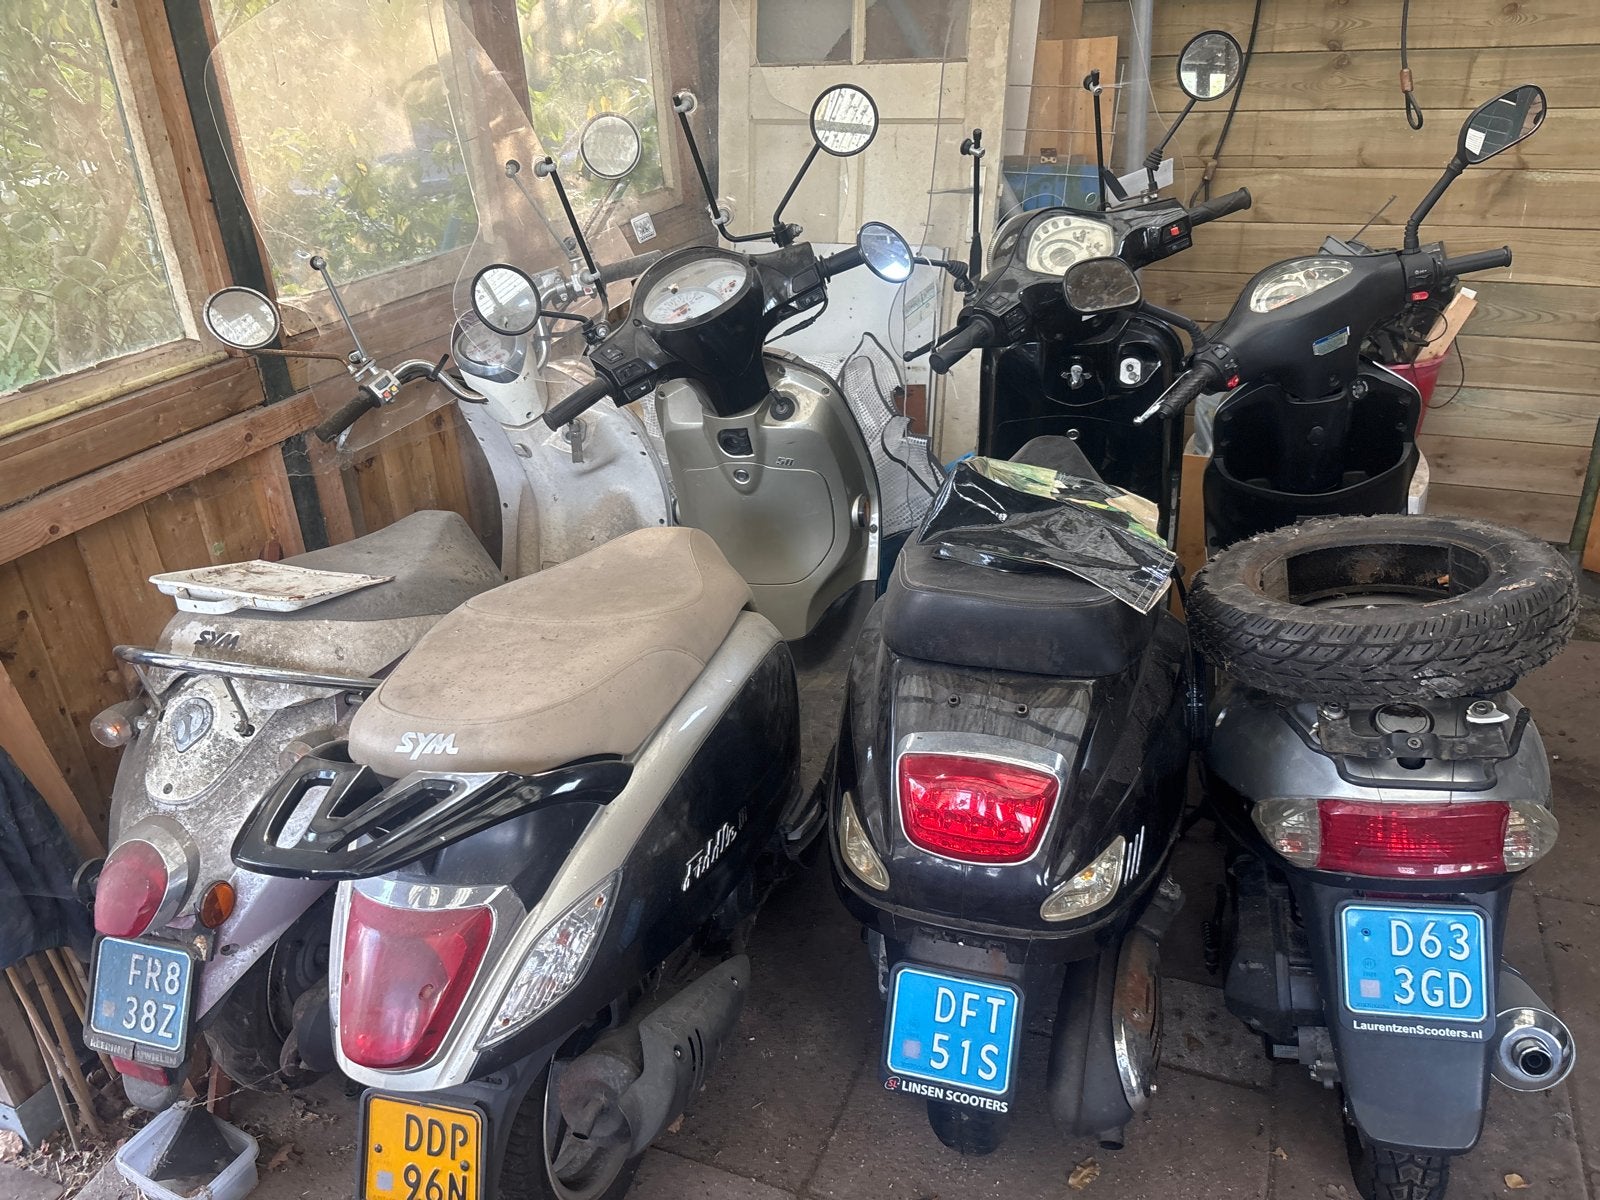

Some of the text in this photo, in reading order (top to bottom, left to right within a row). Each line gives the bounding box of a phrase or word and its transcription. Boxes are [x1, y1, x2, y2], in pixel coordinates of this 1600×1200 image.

[193, 630, 241, 652] SYM
[394, 731, 459, 761] SYM
[1390, 919, 1471, 961] D63
[128, 953, 181, 995] FR8
[1393, 967, 1473, 1009] 3GD
[122, 996, 177, 1039] 38Z
[934, 986, 1006, 1034] DFT
[1353, 1020, 1483, 1040] LaurentzenScooters.nl
[929, 1032, 999, 1081] 51S
[901, 1080, 943, 1099] LINSEN
[945, 1090, 1009, 1113] SCOOTERS
[404, 1113, 469, 1161] DDP
[403, 1163, 468, 1200] 96N
